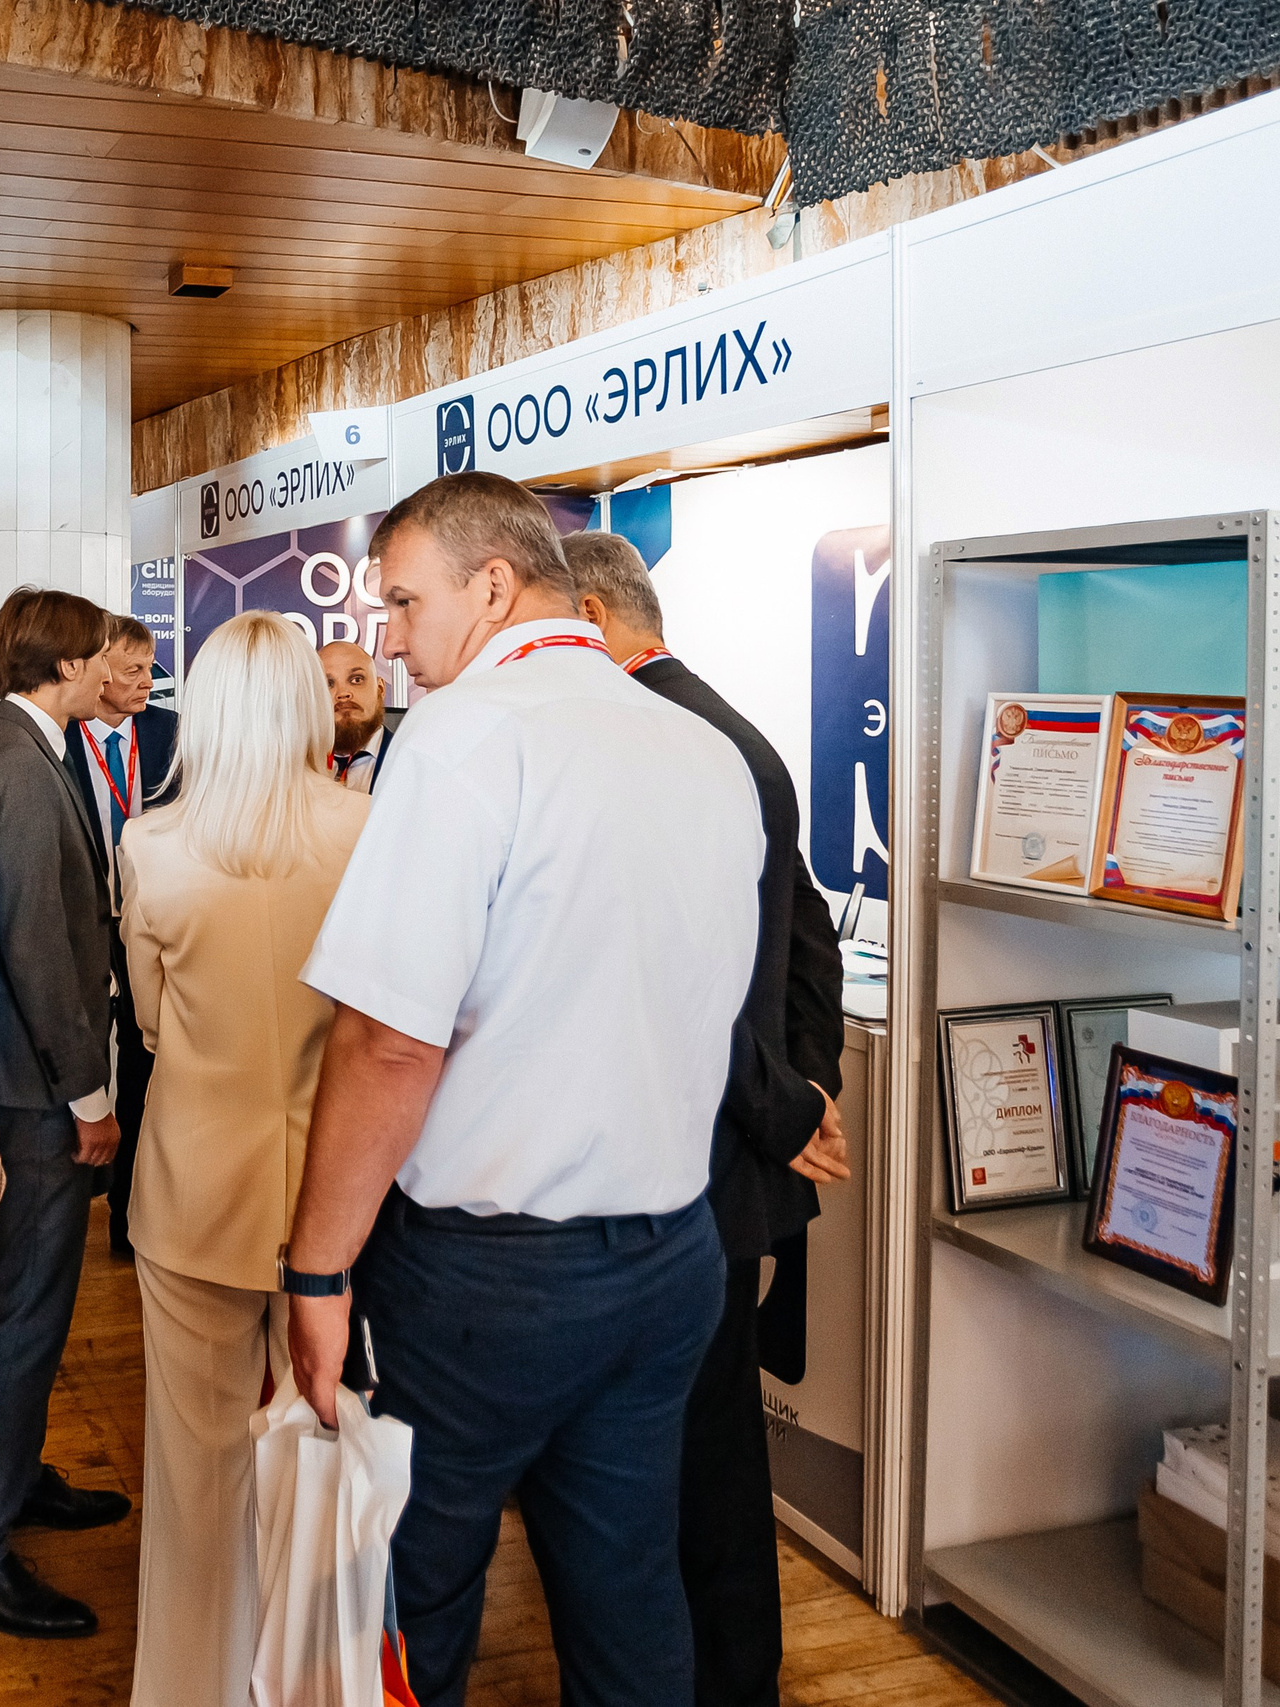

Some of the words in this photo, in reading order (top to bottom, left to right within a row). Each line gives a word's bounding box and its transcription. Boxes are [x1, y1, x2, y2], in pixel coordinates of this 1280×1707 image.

[488, 385, 571, 452] ООО
[585, 320, 792, 423] «ЭРЛИХ»
[345, 424, 361, 445] 6
[444, 433, 467, 448] ЭРЛИХ
[225, 479, 264, 521] ООО
[269, 460, 355, 508] «ЭРЛИХ»
[996, 1104, 1042, 1120] ДИПЛОМ
[1130, 1110, 1216, 1147] БЛАГОДАРНОСТЬ
